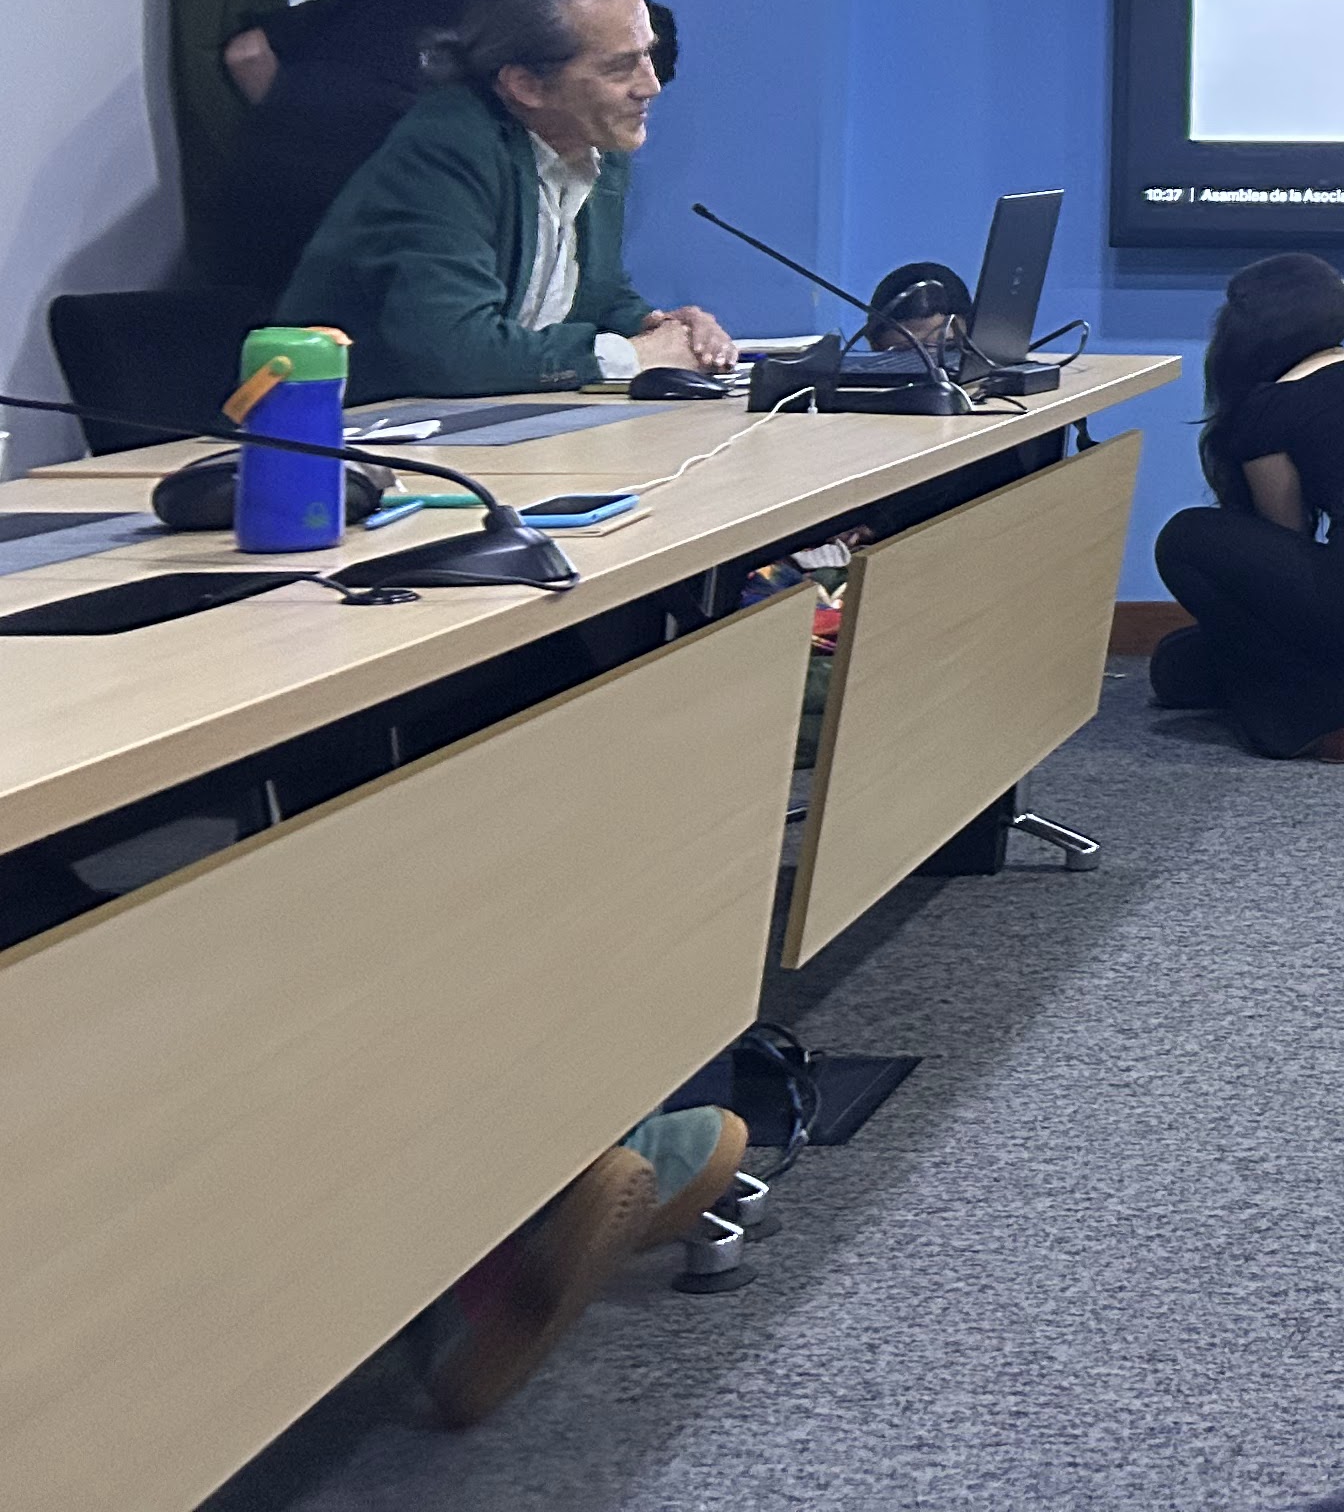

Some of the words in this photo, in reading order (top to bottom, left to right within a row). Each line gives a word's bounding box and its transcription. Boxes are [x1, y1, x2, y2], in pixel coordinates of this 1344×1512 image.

[1144, 188, 1183, 202] 10:37
[1200, 188, 1268, 203] Asamblea
[1269, 188, 1288, 203] de
[1289, 188, 1302, 203] la
